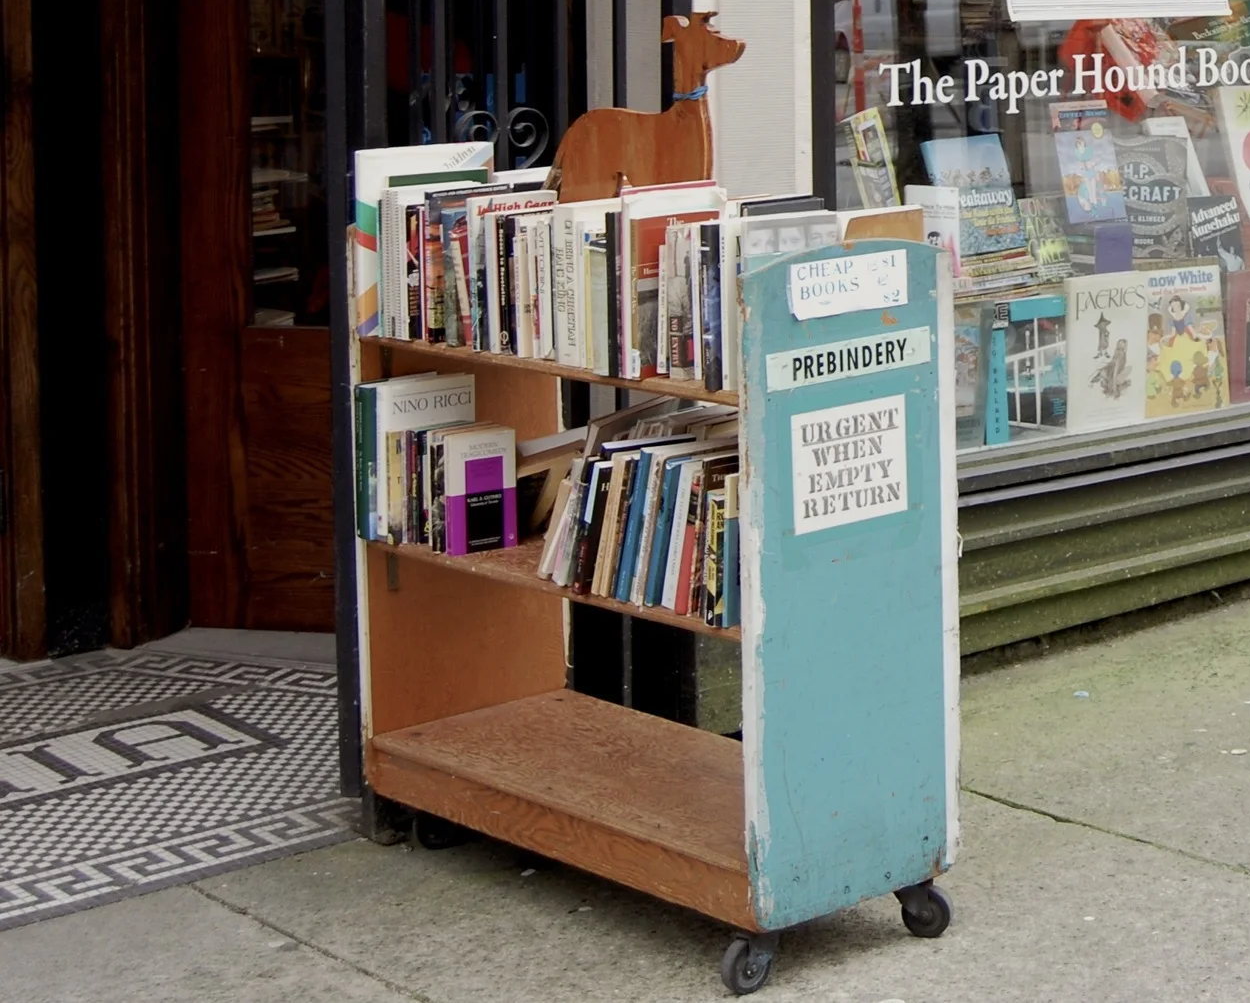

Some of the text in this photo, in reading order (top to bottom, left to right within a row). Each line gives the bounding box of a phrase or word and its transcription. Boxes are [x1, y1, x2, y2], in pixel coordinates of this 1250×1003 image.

[879, 58, 956, 108] The
[964, 57, 1064, 115] Paper
[1072, 46, 1187, 96] Hound
[959, 188, 1013, 207] eakaway
[1122, 185, 1181, 202] ECRAFT
[1191, 197, 1238, 225] Advanced
[1191, 211, 1240, 239] Nunchaku
[796, 260, 854, 281] CHEAP
[1148, 269, 1214, 287] now White
[800, 278, 860, 301] BOOKS
[1075, 285, 1146, 320] FAERIES
[671, 317, 680, 366] NO ENTRY
[792, 337, 907, 382] PREBINDERY
[393, 390, 472, 415] NINO RICCI
[801, 407, 899, 444] URGENT
[811, 435, 883, 467] WHEN
[808, 458, 893, 494] EMPTY
[803, 481, 901, 519] RETURN
